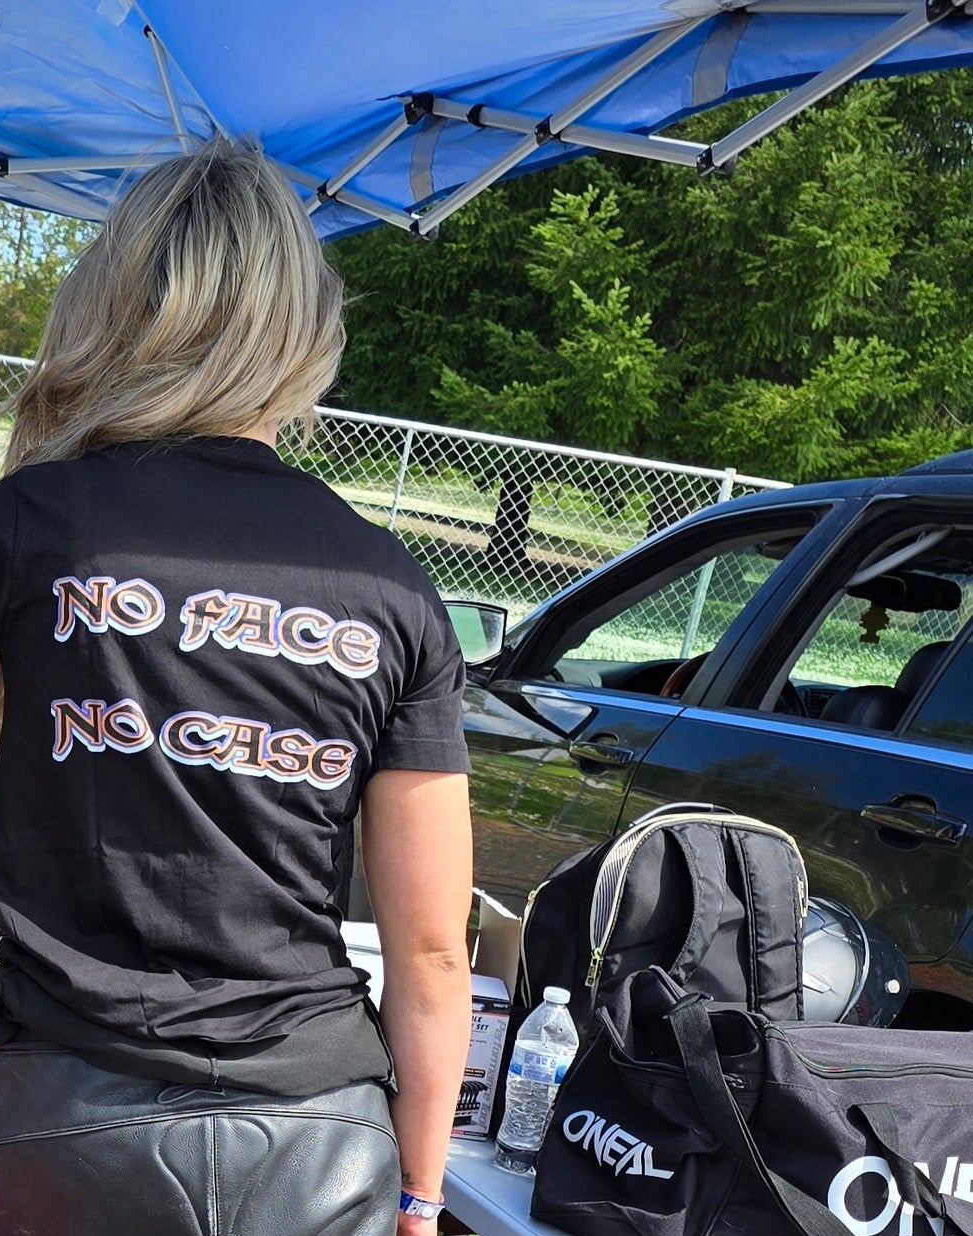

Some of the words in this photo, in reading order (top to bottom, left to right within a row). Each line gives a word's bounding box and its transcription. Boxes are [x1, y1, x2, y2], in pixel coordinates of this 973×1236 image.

[53, 577, 165, 642] NO
[179, 589, 381, 679] FACE
[51, 698, 154, 761] NO
[159, 711, 359, 790] CASE
